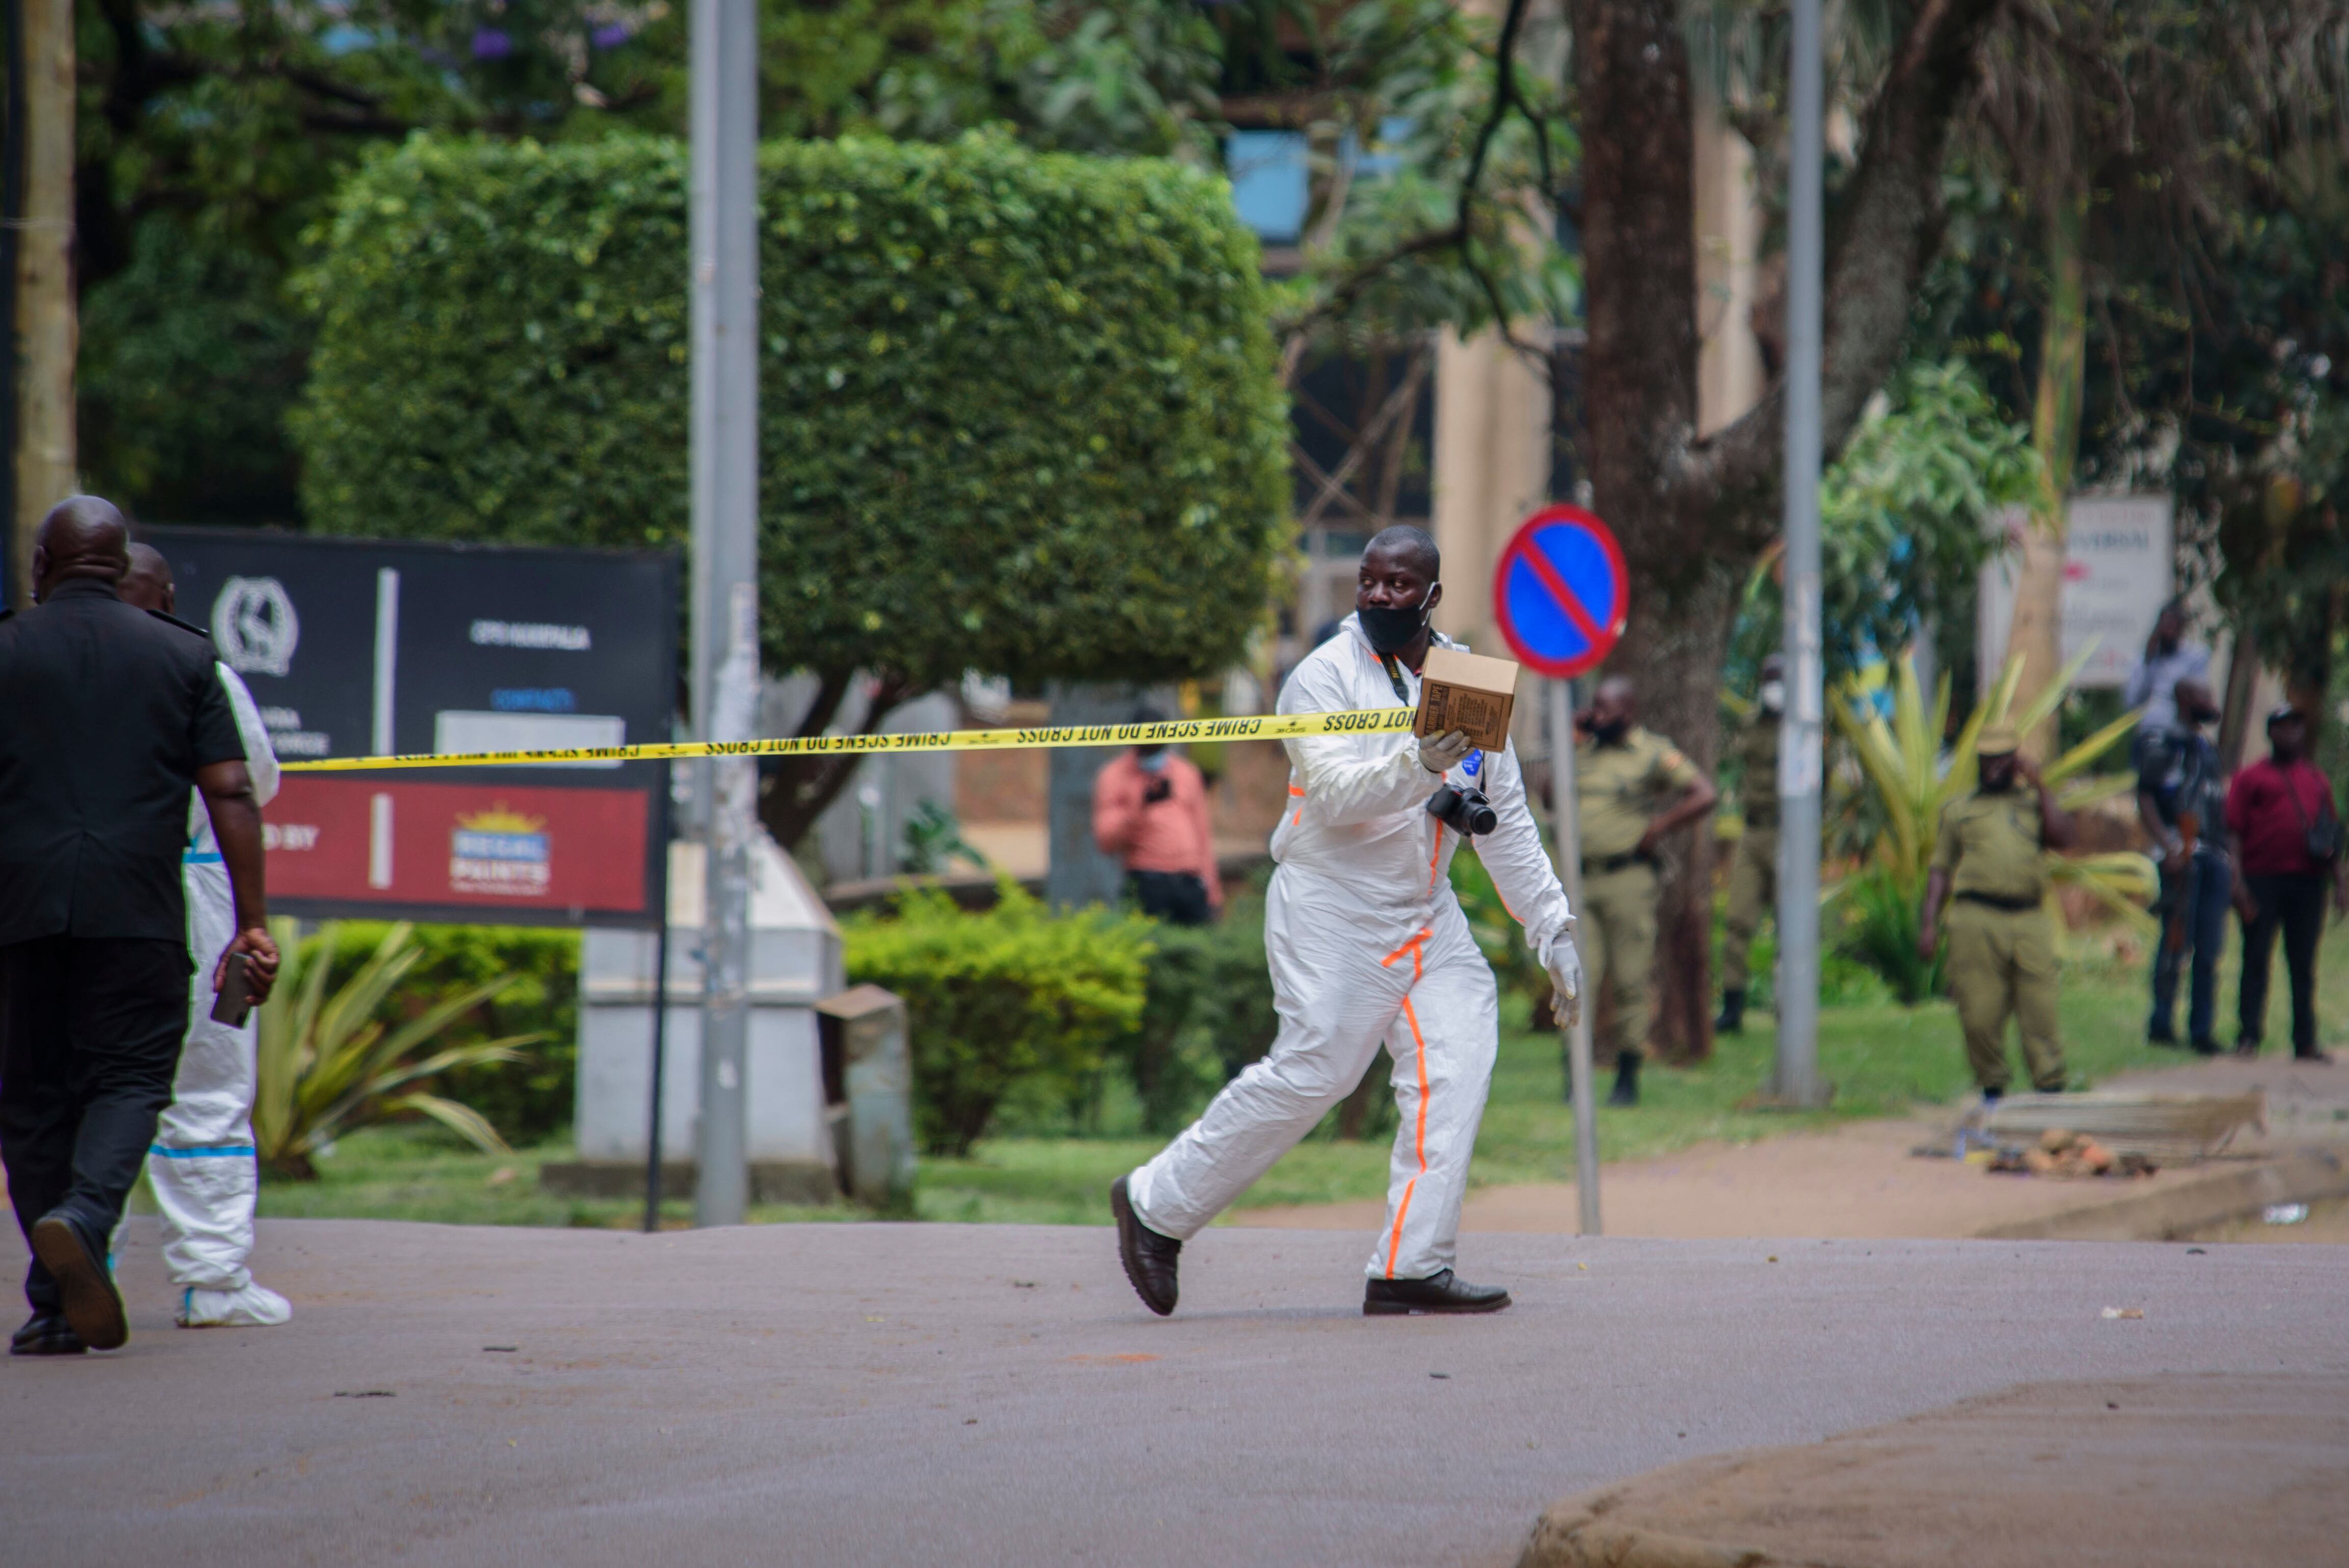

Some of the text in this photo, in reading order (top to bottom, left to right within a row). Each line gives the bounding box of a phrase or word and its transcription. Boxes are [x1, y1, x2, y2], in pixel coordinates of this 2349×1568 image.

[1430, 685, 1442, 702] TAPE
[1323, 711, 1416, 731] NOT CROSS
[1017, 719, 1262, 743] CRIME SCENE DO NOT CROSS
[807, 738, 828, 750] DO
[835, 734, 889, 749] SCENE
[895, 732, 951, 747] CRIME
